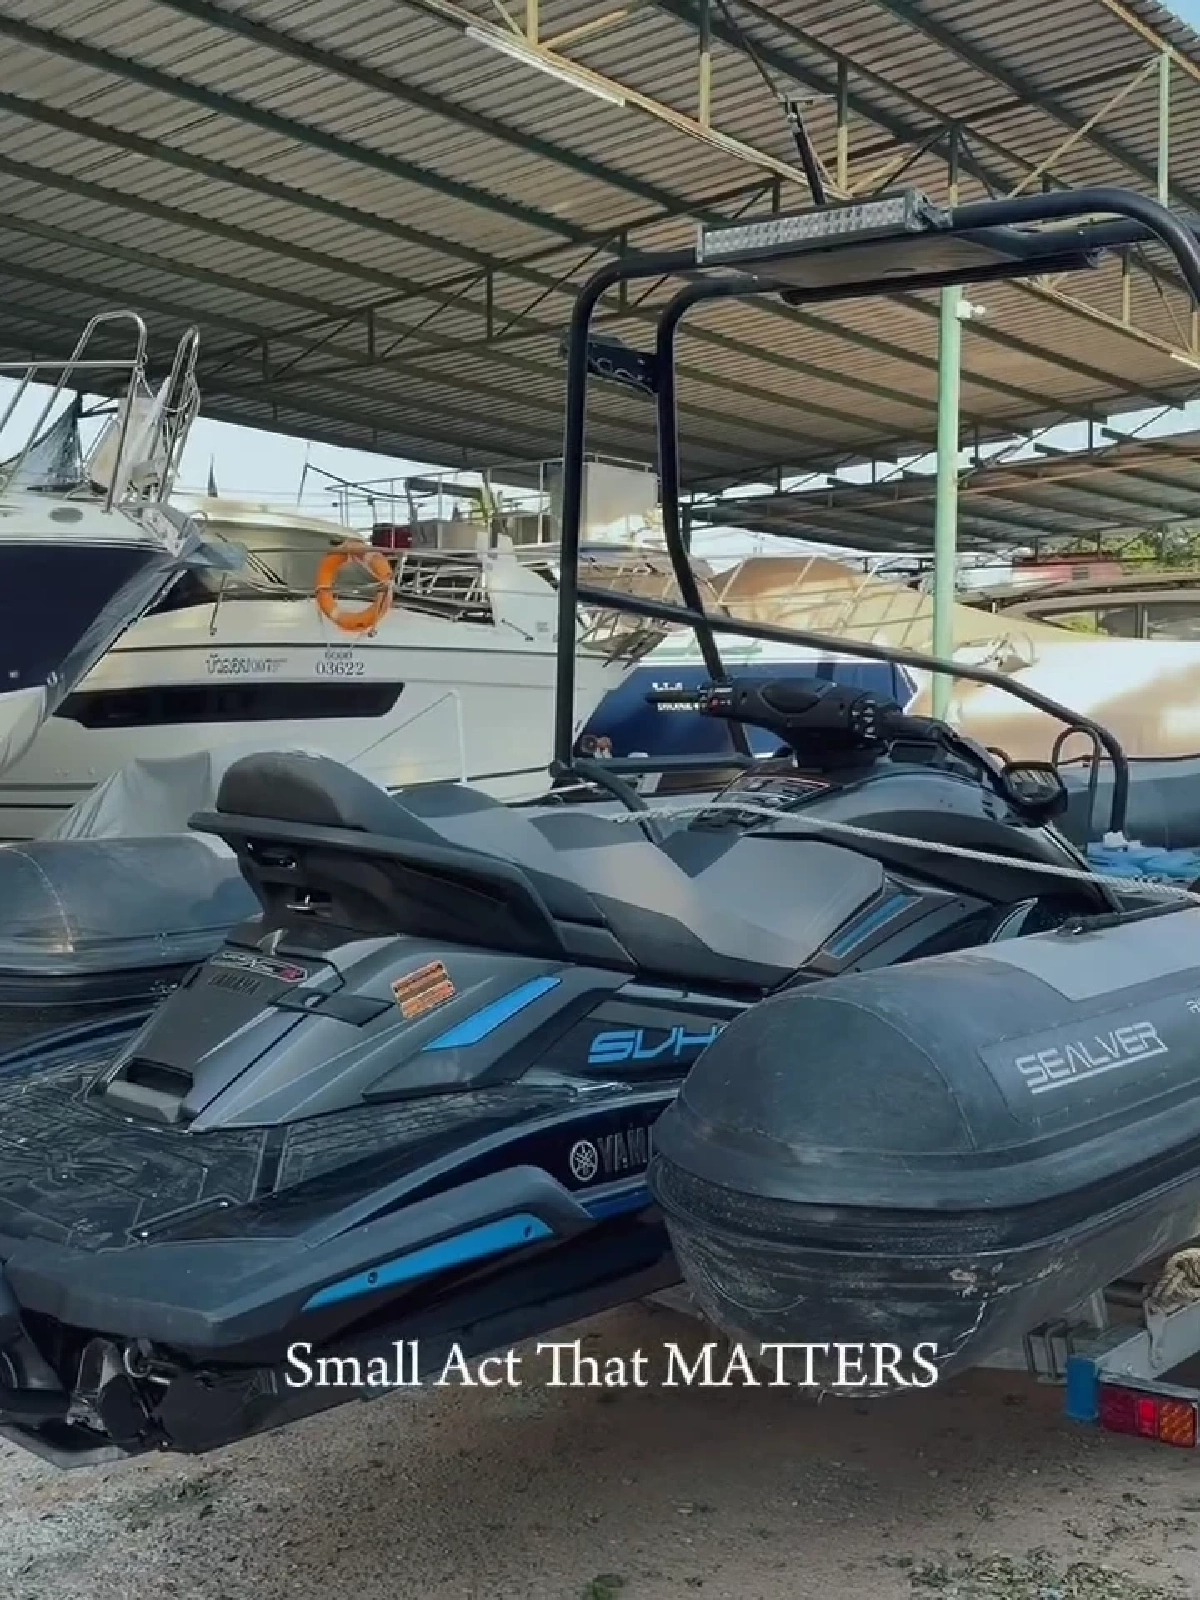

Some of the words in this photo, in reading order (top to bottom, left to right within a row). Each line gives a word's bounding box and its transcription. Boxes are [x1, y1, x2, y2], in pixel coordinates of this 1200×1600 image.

[316, 661, 365, 676] 03622
[1014, 1021, 1168, 1089] SEALVER
[597, 1125, 653, 1173] YAM
